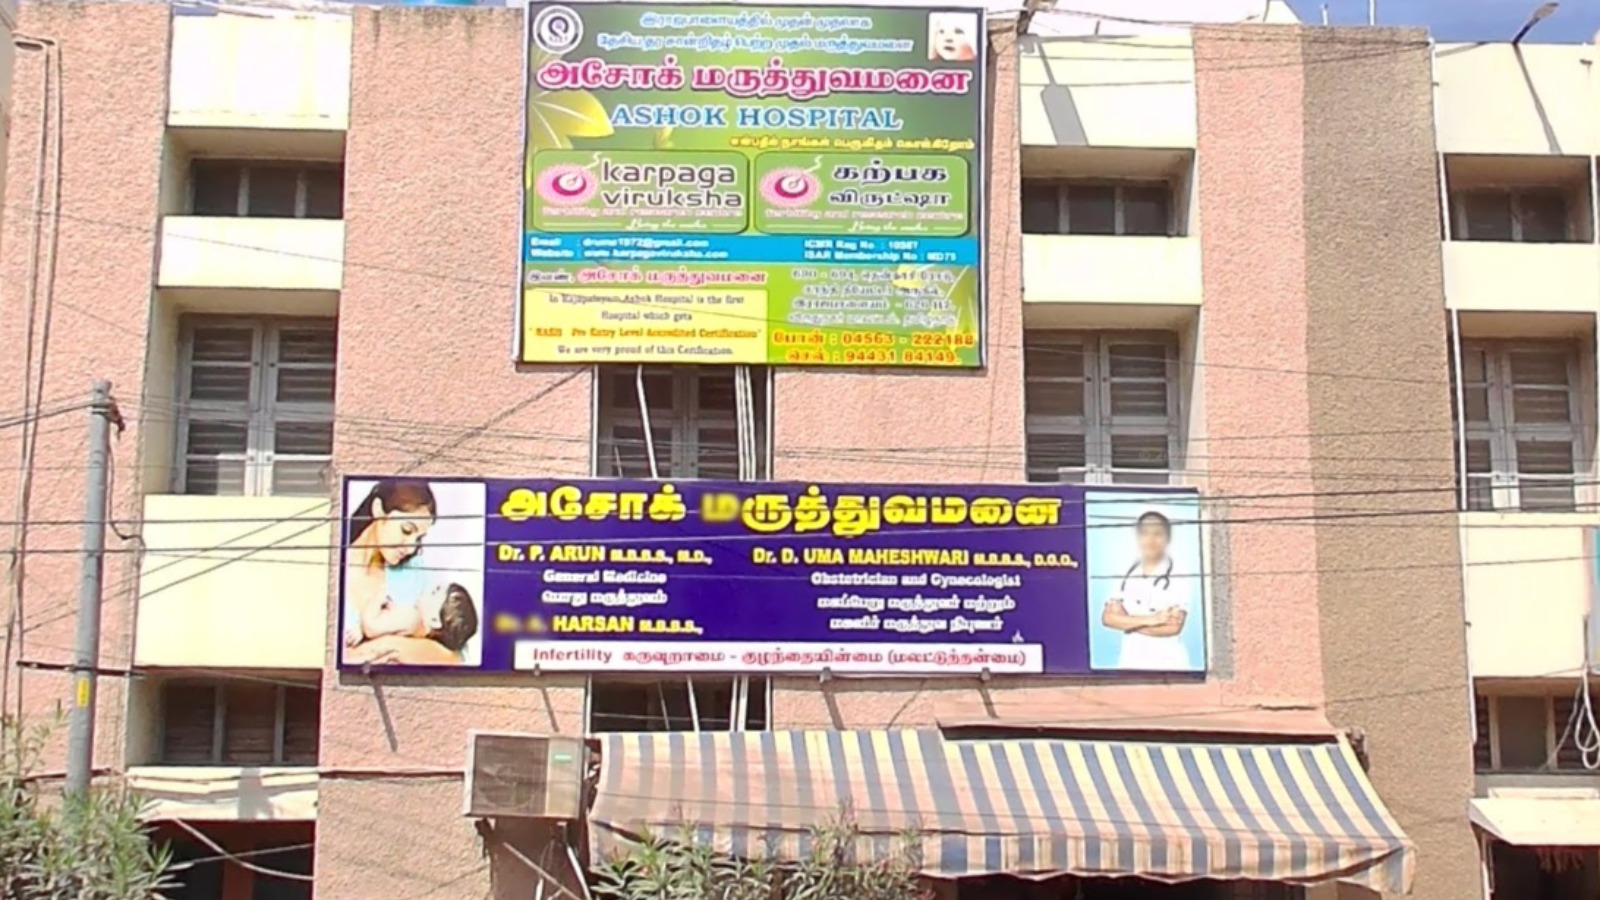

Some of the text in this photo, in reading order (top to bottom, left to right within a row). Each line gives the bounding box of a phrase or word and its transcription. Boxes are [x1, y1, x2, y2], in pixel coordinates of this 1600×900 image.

[537, 55, 972, 100] அசோக் மருத்துவமனை
[611, 104, 903, 130] ASHOK HOSPITAL
[601, 159, 738, 190] karpaga
[831, 158, 949, 187] கற்பக
[601, 189, 744, 209] viruksha
[841, 333, 894, 345] 04563
[845, 350, 896, 363] 94431
[500, 484, 686, 521] அசோக்
[499, 545, 525, 561] Dr.
[550, 546, 605, 562] ARUN
[753, 547, 777, 563] Dr.
[804, 548, 844, 564] UMA
[849, 549, 969, 566] MAHESHWARI
[543, 570, 667, 584] General Medicine
[901, 573, 928, 586] and
[553, 616, 634, 633] HARSAN
[534, 649, 612, 662] Infertility
